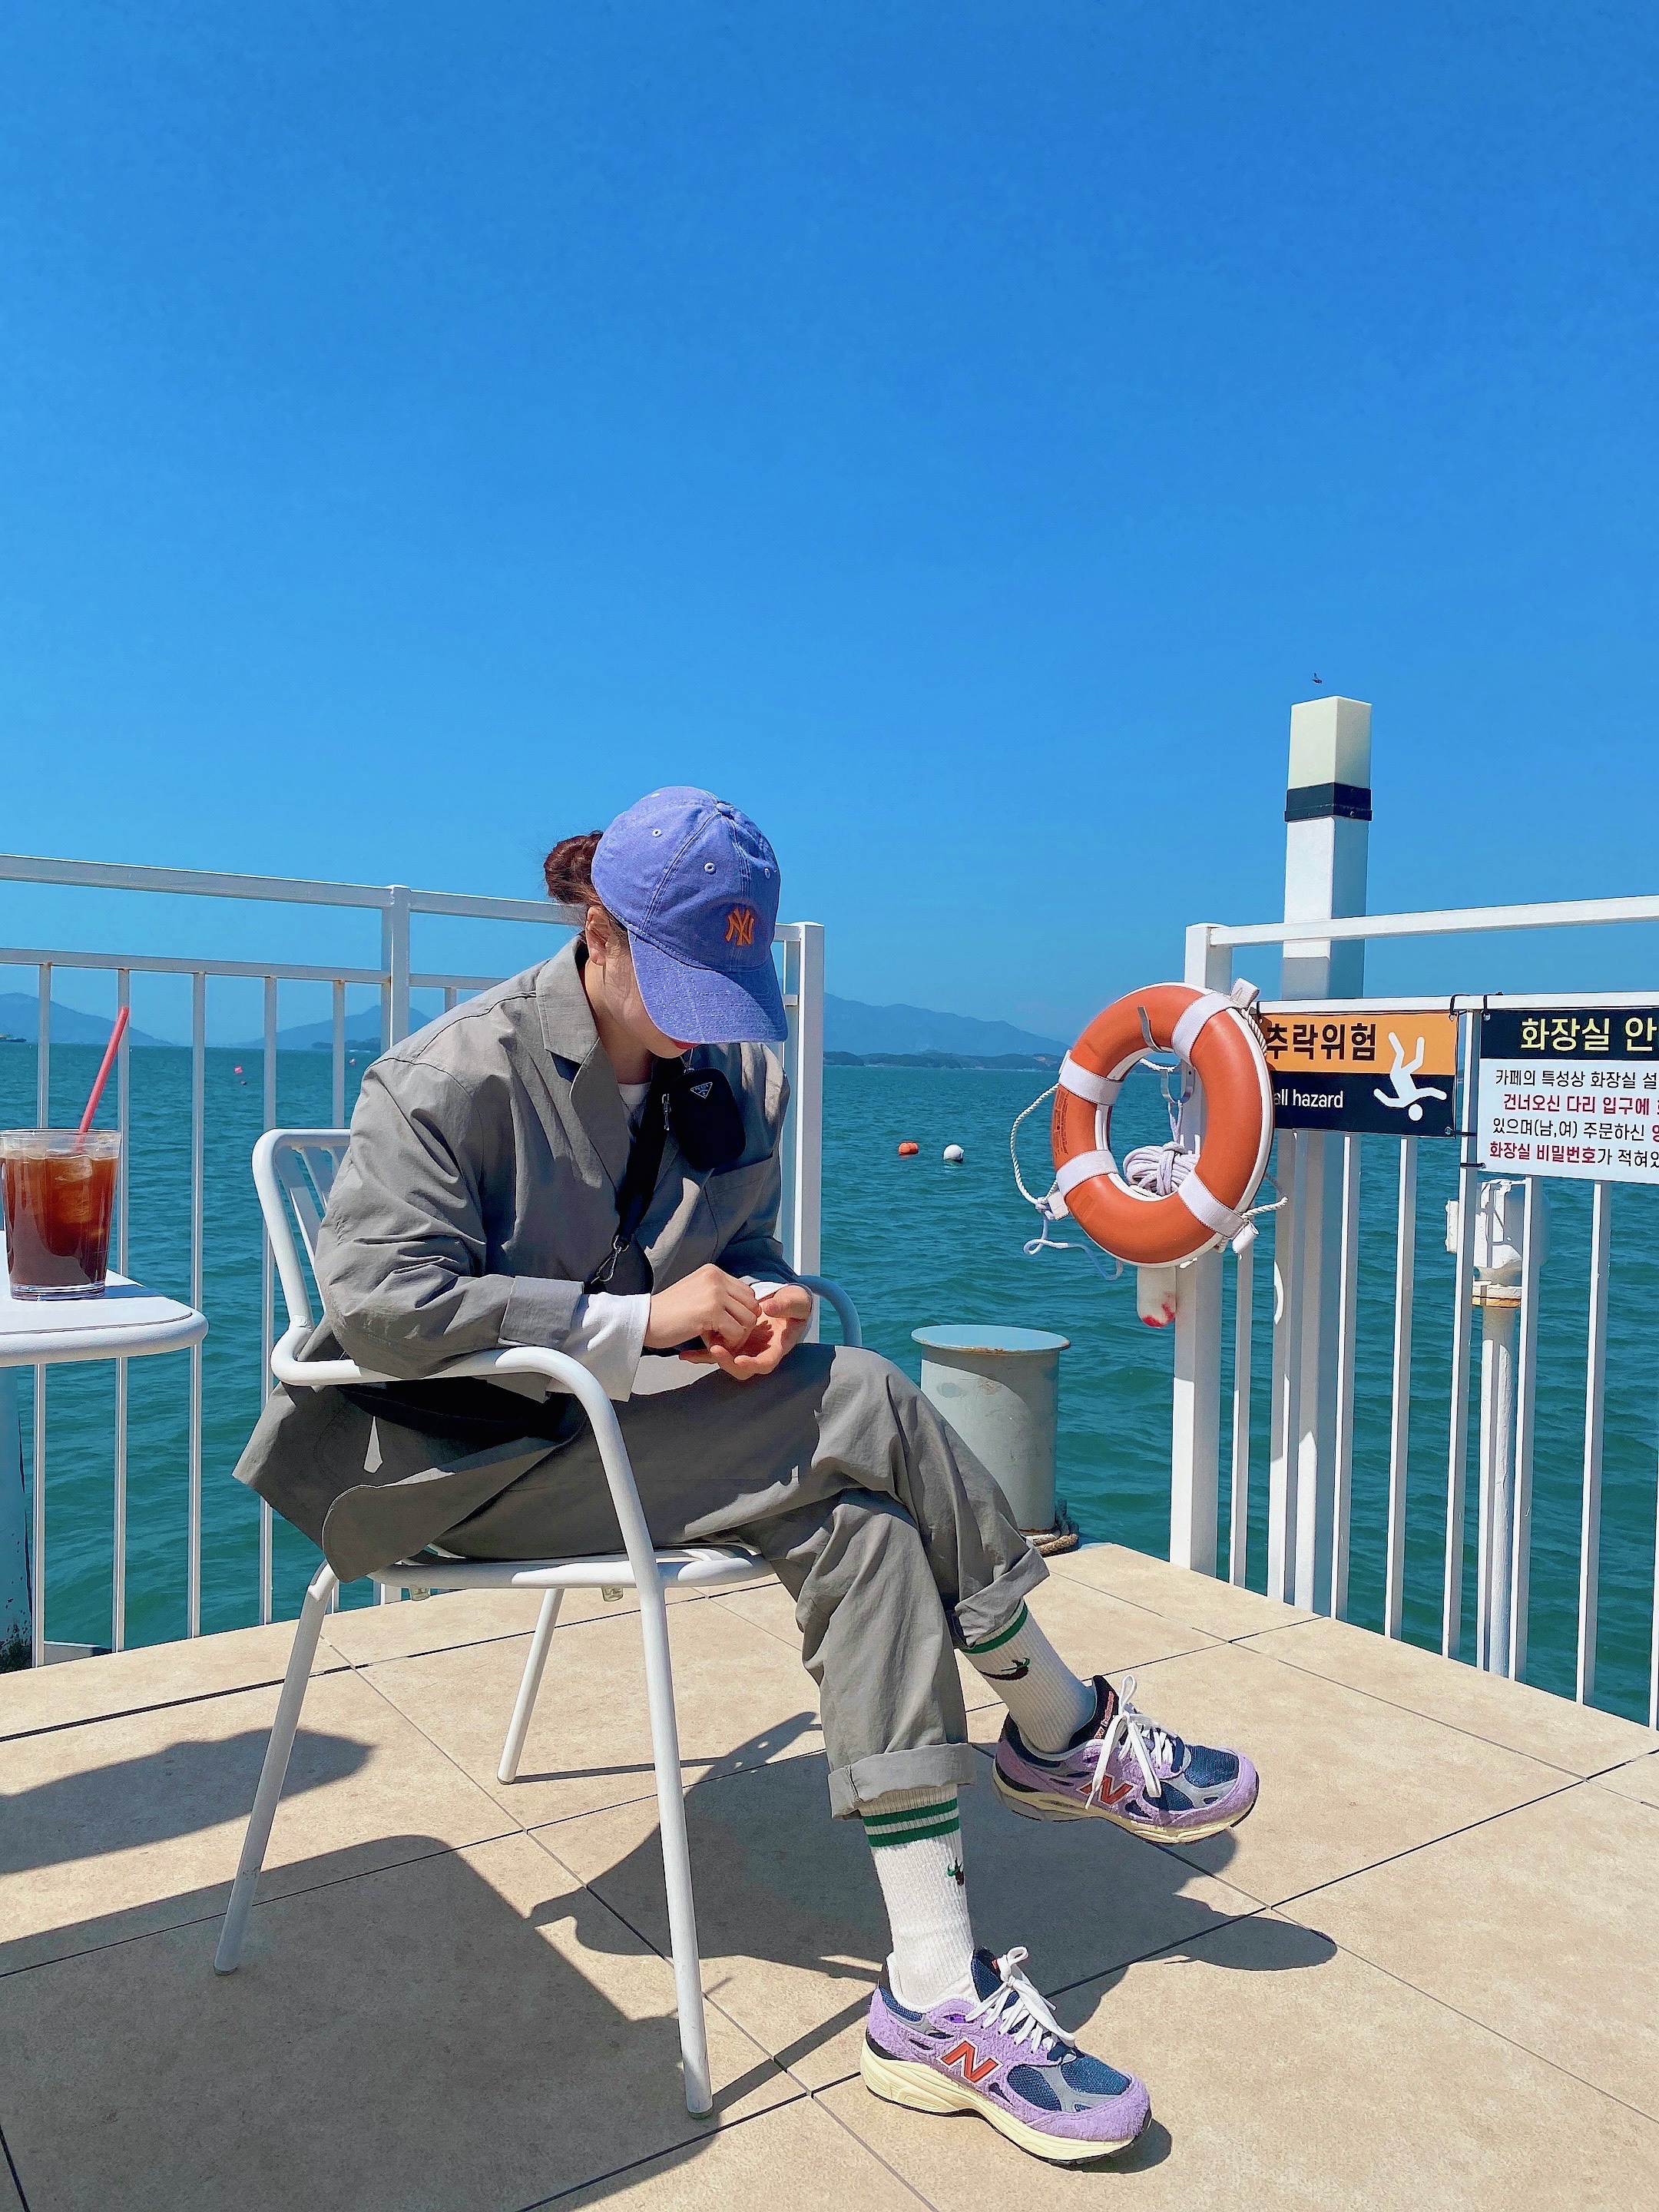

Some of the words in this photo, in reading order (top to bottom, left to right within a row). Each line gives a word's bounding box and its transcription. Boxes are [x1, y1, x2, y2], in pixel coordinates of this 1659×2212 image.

[725, 906, 755, 945] NY
[1266, 1022, 1376, 1061] 추락위험
[1520, 1018, 1610, 1052] 화장실
[1495, 1069, 1536, 1087] 카페의
[1541, 1070, 1585, 1088] 특성상
[1591, 1071, 1636, 1089] 화장실
[1293, 1088, 1343, 1108] hazard
[1504, 1093, 1560, 1112] 건너오신
[1567, 1095, 1596, 1114] 다리
[1603, 1097, 1650, 1115] 입구에
[1492, 1118, 1578, 1138] 있으며(남,여)
[1583, 1121, 1644, 1141] 주문하신
[1489, 1141, 1531, 1161] 화장실
[1536, 1144, 1613, 1166] 비밀번호가
[936, 2039, 1002, 2085] N
